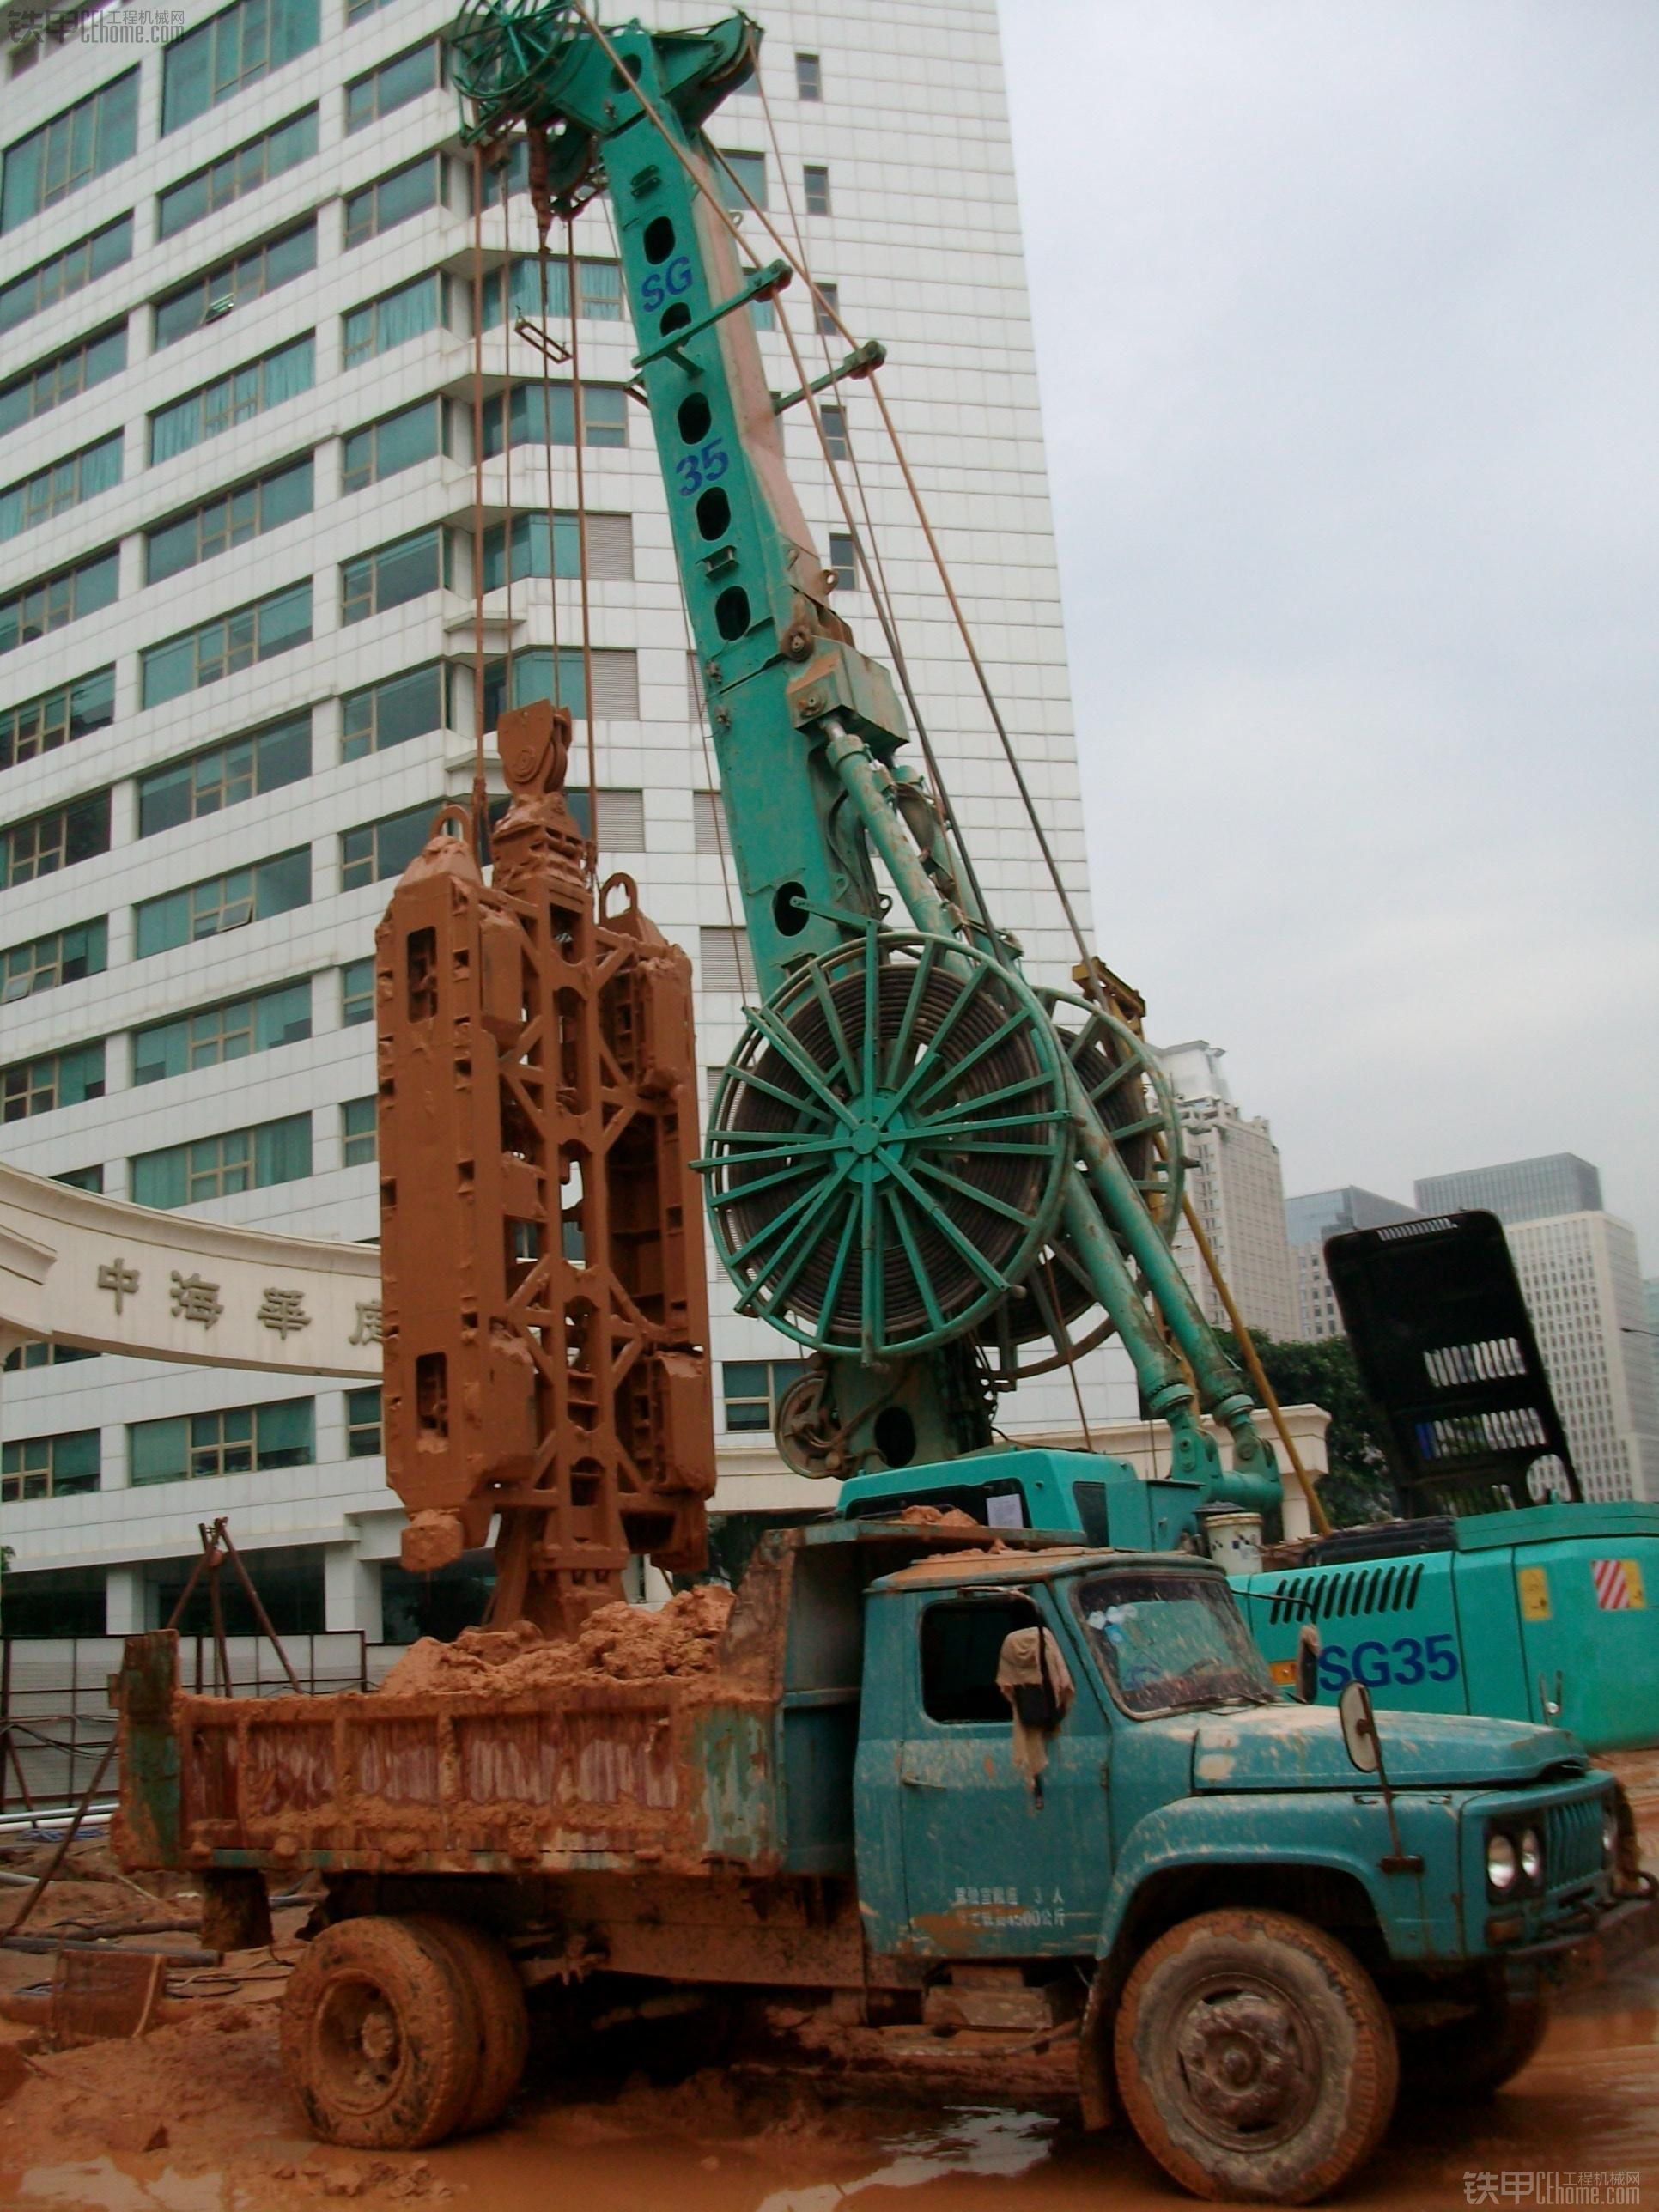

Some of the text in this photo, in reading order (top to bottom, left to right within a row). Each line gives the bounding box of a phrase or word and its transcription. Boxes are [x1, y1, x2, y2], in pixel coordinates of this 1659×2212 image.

[641, 256, 693, 313] SG
[676, 437, 729, 496] 35
[1319, 1633, 1459, 1692] SG35
